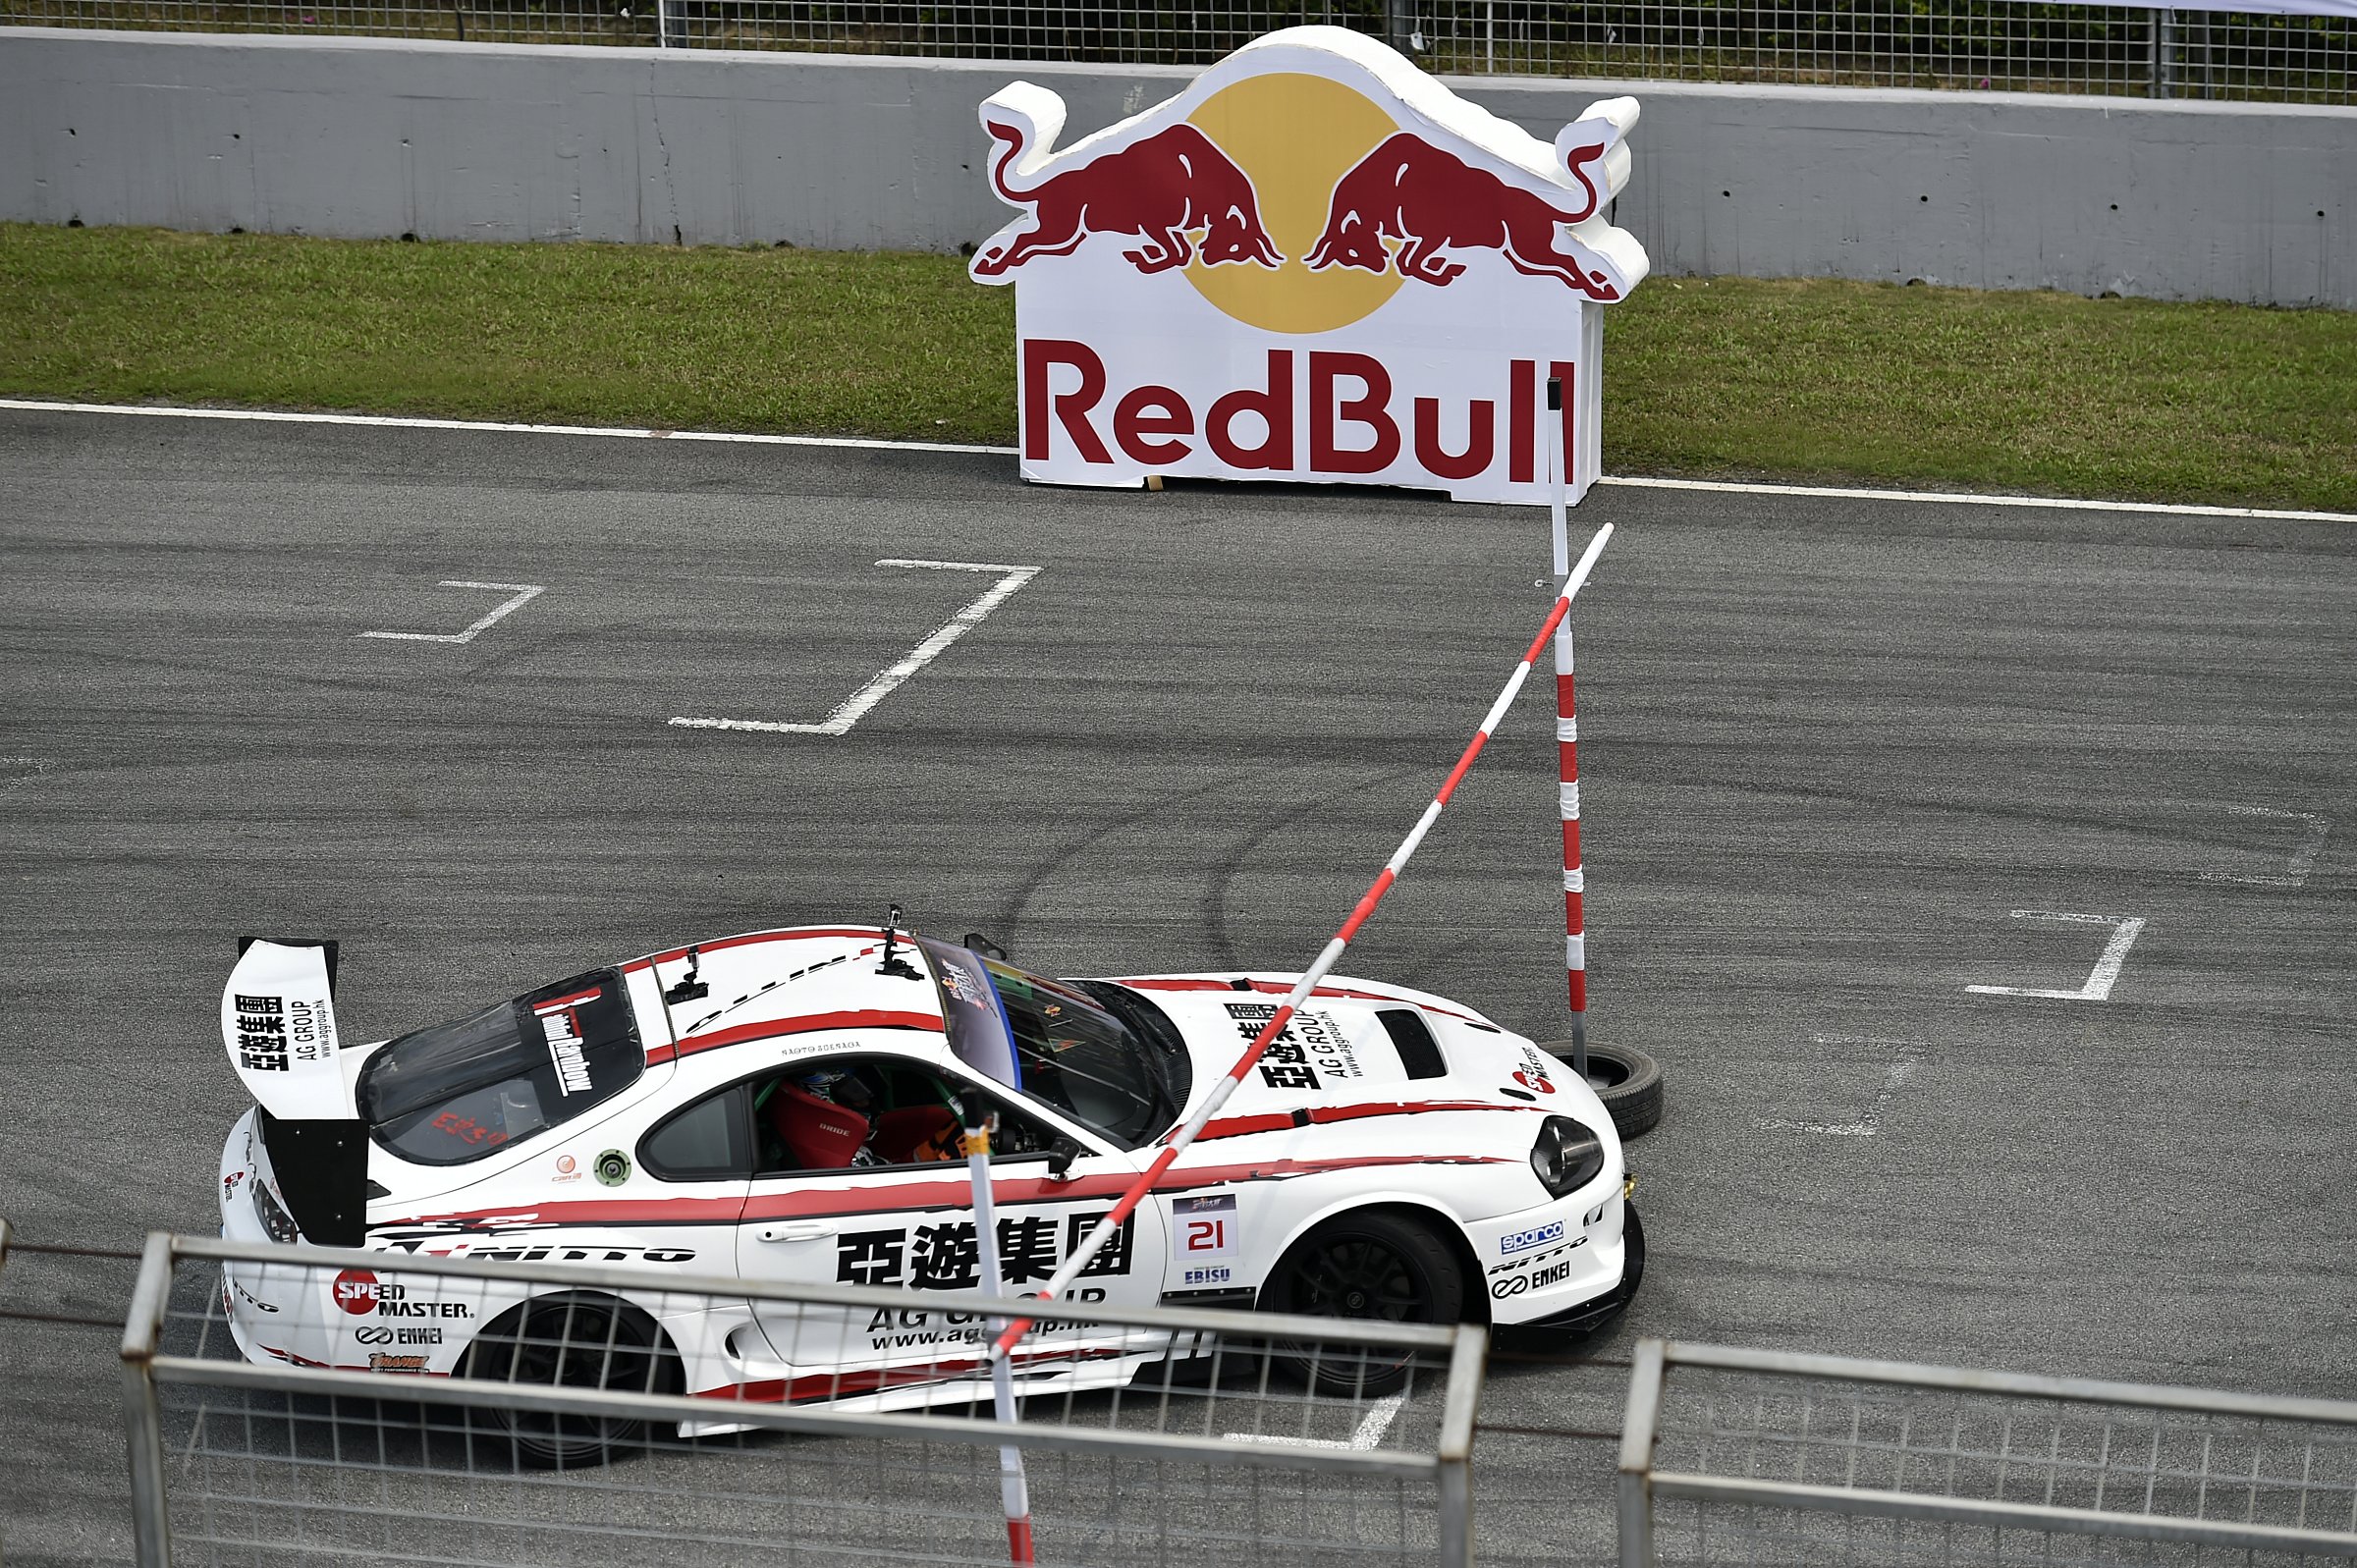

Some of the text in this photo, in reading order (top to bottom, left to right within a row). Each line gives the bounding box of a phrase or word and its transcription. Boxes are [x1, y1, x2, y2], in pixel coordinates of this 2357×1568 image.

[235, 994, 289, 1071] 亞遊集團
[292, 1000, 316, 1060] AG GROUP
[1294, 1010, 1348, 1078] AG GROUP
[1188, 1220, 1224, 1251] 21
[1503, 1223, 1562, 1251] sparco
[1488, 1235, 1588, 1275] NITTO
[1184, 1269, 1231, 1284] EBISU
[1532, 1261, 1570, 1289] ENKEI
[338, 1282, 406, 1301] SPEED
[397, 1328, 442, 1344] ENKEI
